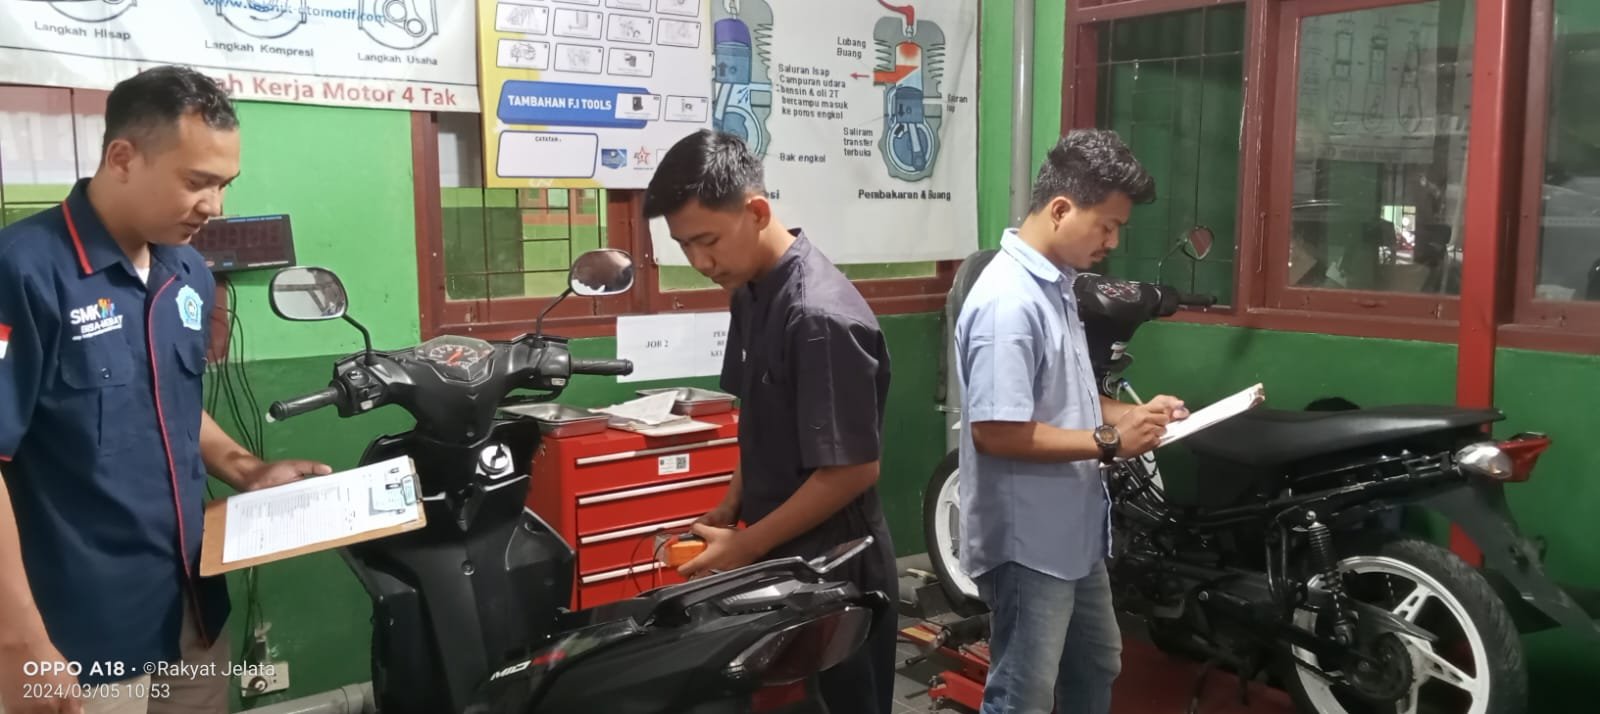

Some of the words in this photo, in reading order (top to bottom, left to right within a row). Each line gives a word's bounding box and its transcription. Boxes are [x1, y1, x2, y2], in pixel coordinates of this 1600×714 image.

[34, 21, 87, 37] Langkah
[205, 39, 254, 52] Langkah
[260, 44, 314, 58] Kompresi
[837, 36, 866, 49] Lubang
[358, 53, 401, 65] Langkah
[407, 55, 438, 66] Usaha
[779, 74, 820, 86] Campuran
[822, 79, 846, 88] udara
[253, 77, 314, 99] Kerja
[323, 82, 395, 103] Motor
[401, 86, 415, 104] 4
[420, 87, 457, 106] Tak
[507, 95, 566, 109] TAMBAHAN
[581, 98, 612, 111] TOOLS
[858, 189, 918, 200] Pembakaran
[70, 304, 101, 325] SMK
